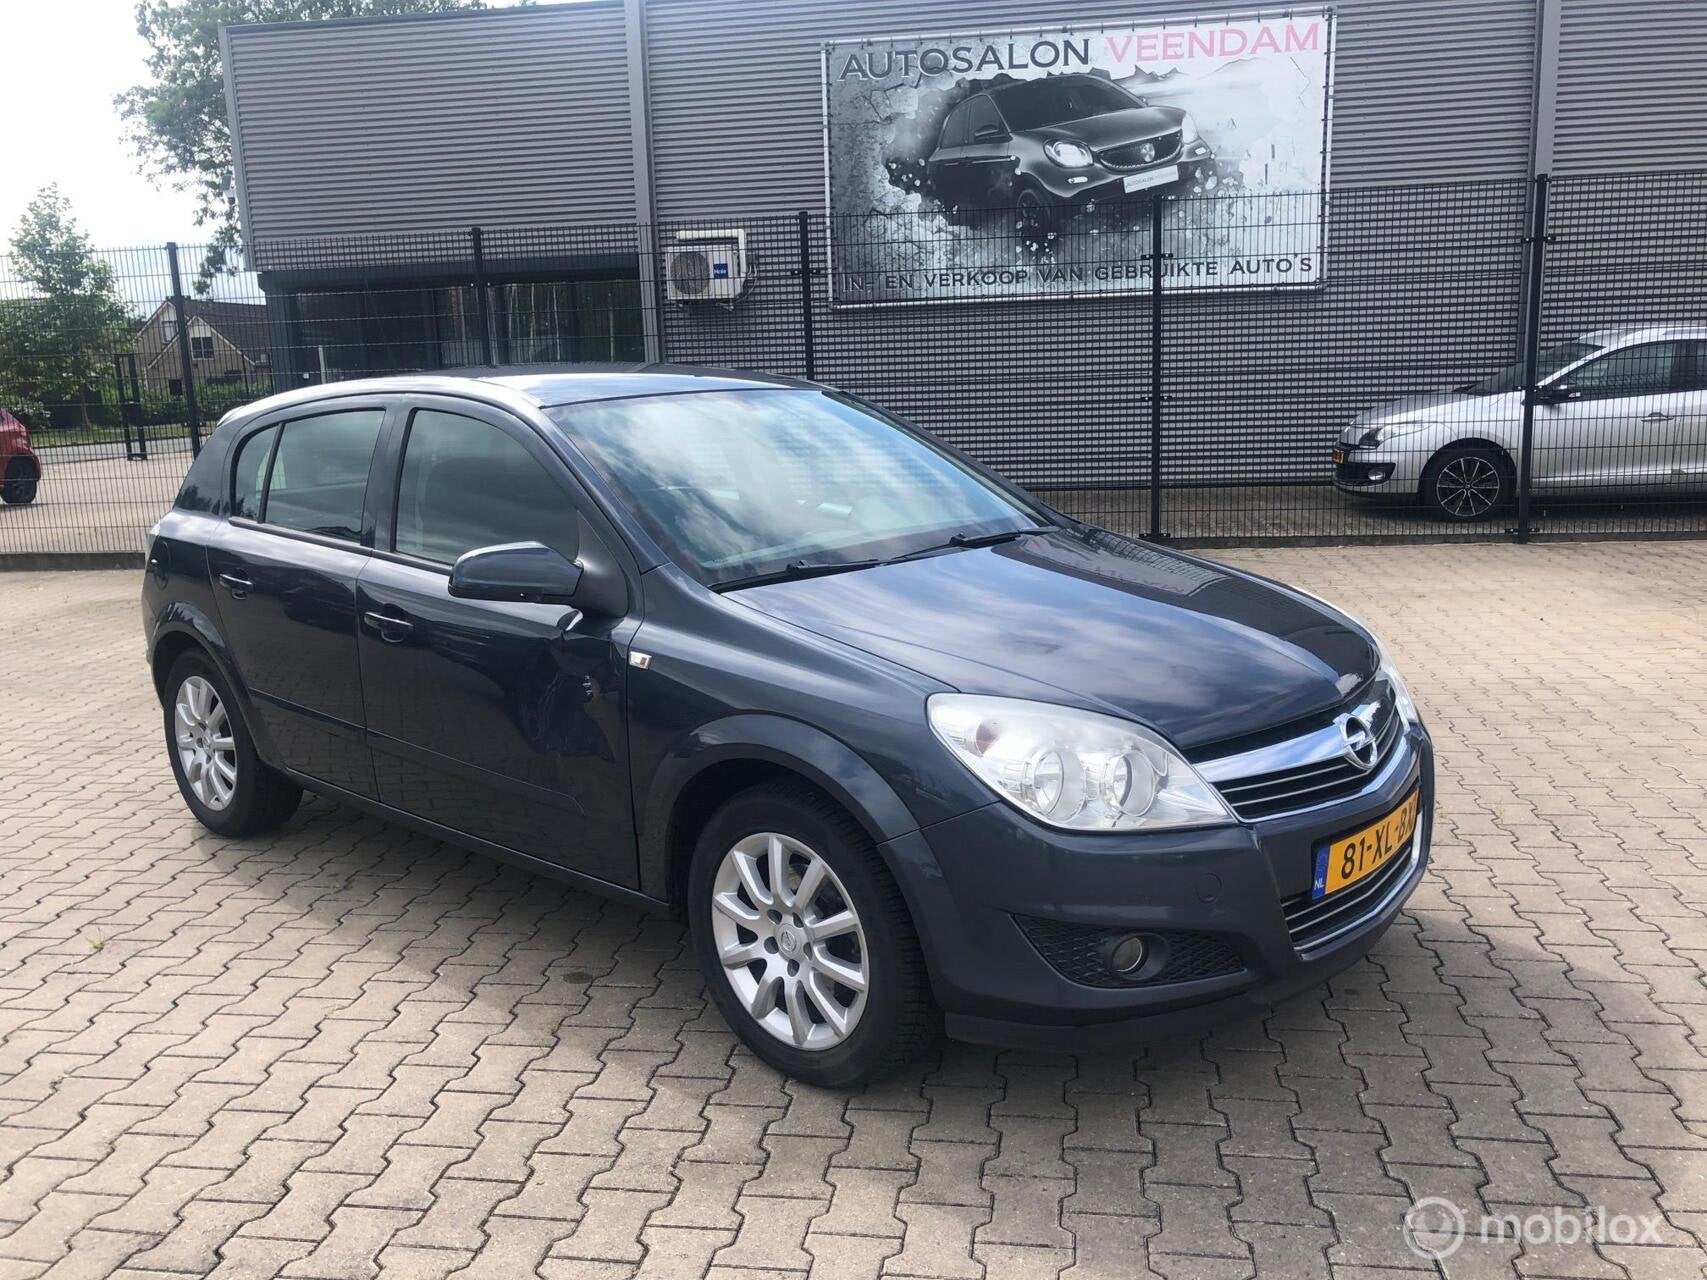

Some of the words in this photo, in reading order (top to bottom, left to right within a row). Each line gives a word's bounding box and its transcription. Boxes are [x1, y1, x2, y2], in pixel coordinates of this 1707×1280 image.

[838, 38, 1090, 82] AUTOSALON
[1105, 22, 1320, 64] VEENDAM
[885, 274, 914, 290] EN
[924, 270, 1028, 288] VERKOOP
[1037, 266, 1084, 283] VAN
[1228, 253, 1313, 276] AUTO'S
[1314, 878, 1325, 890] NL
